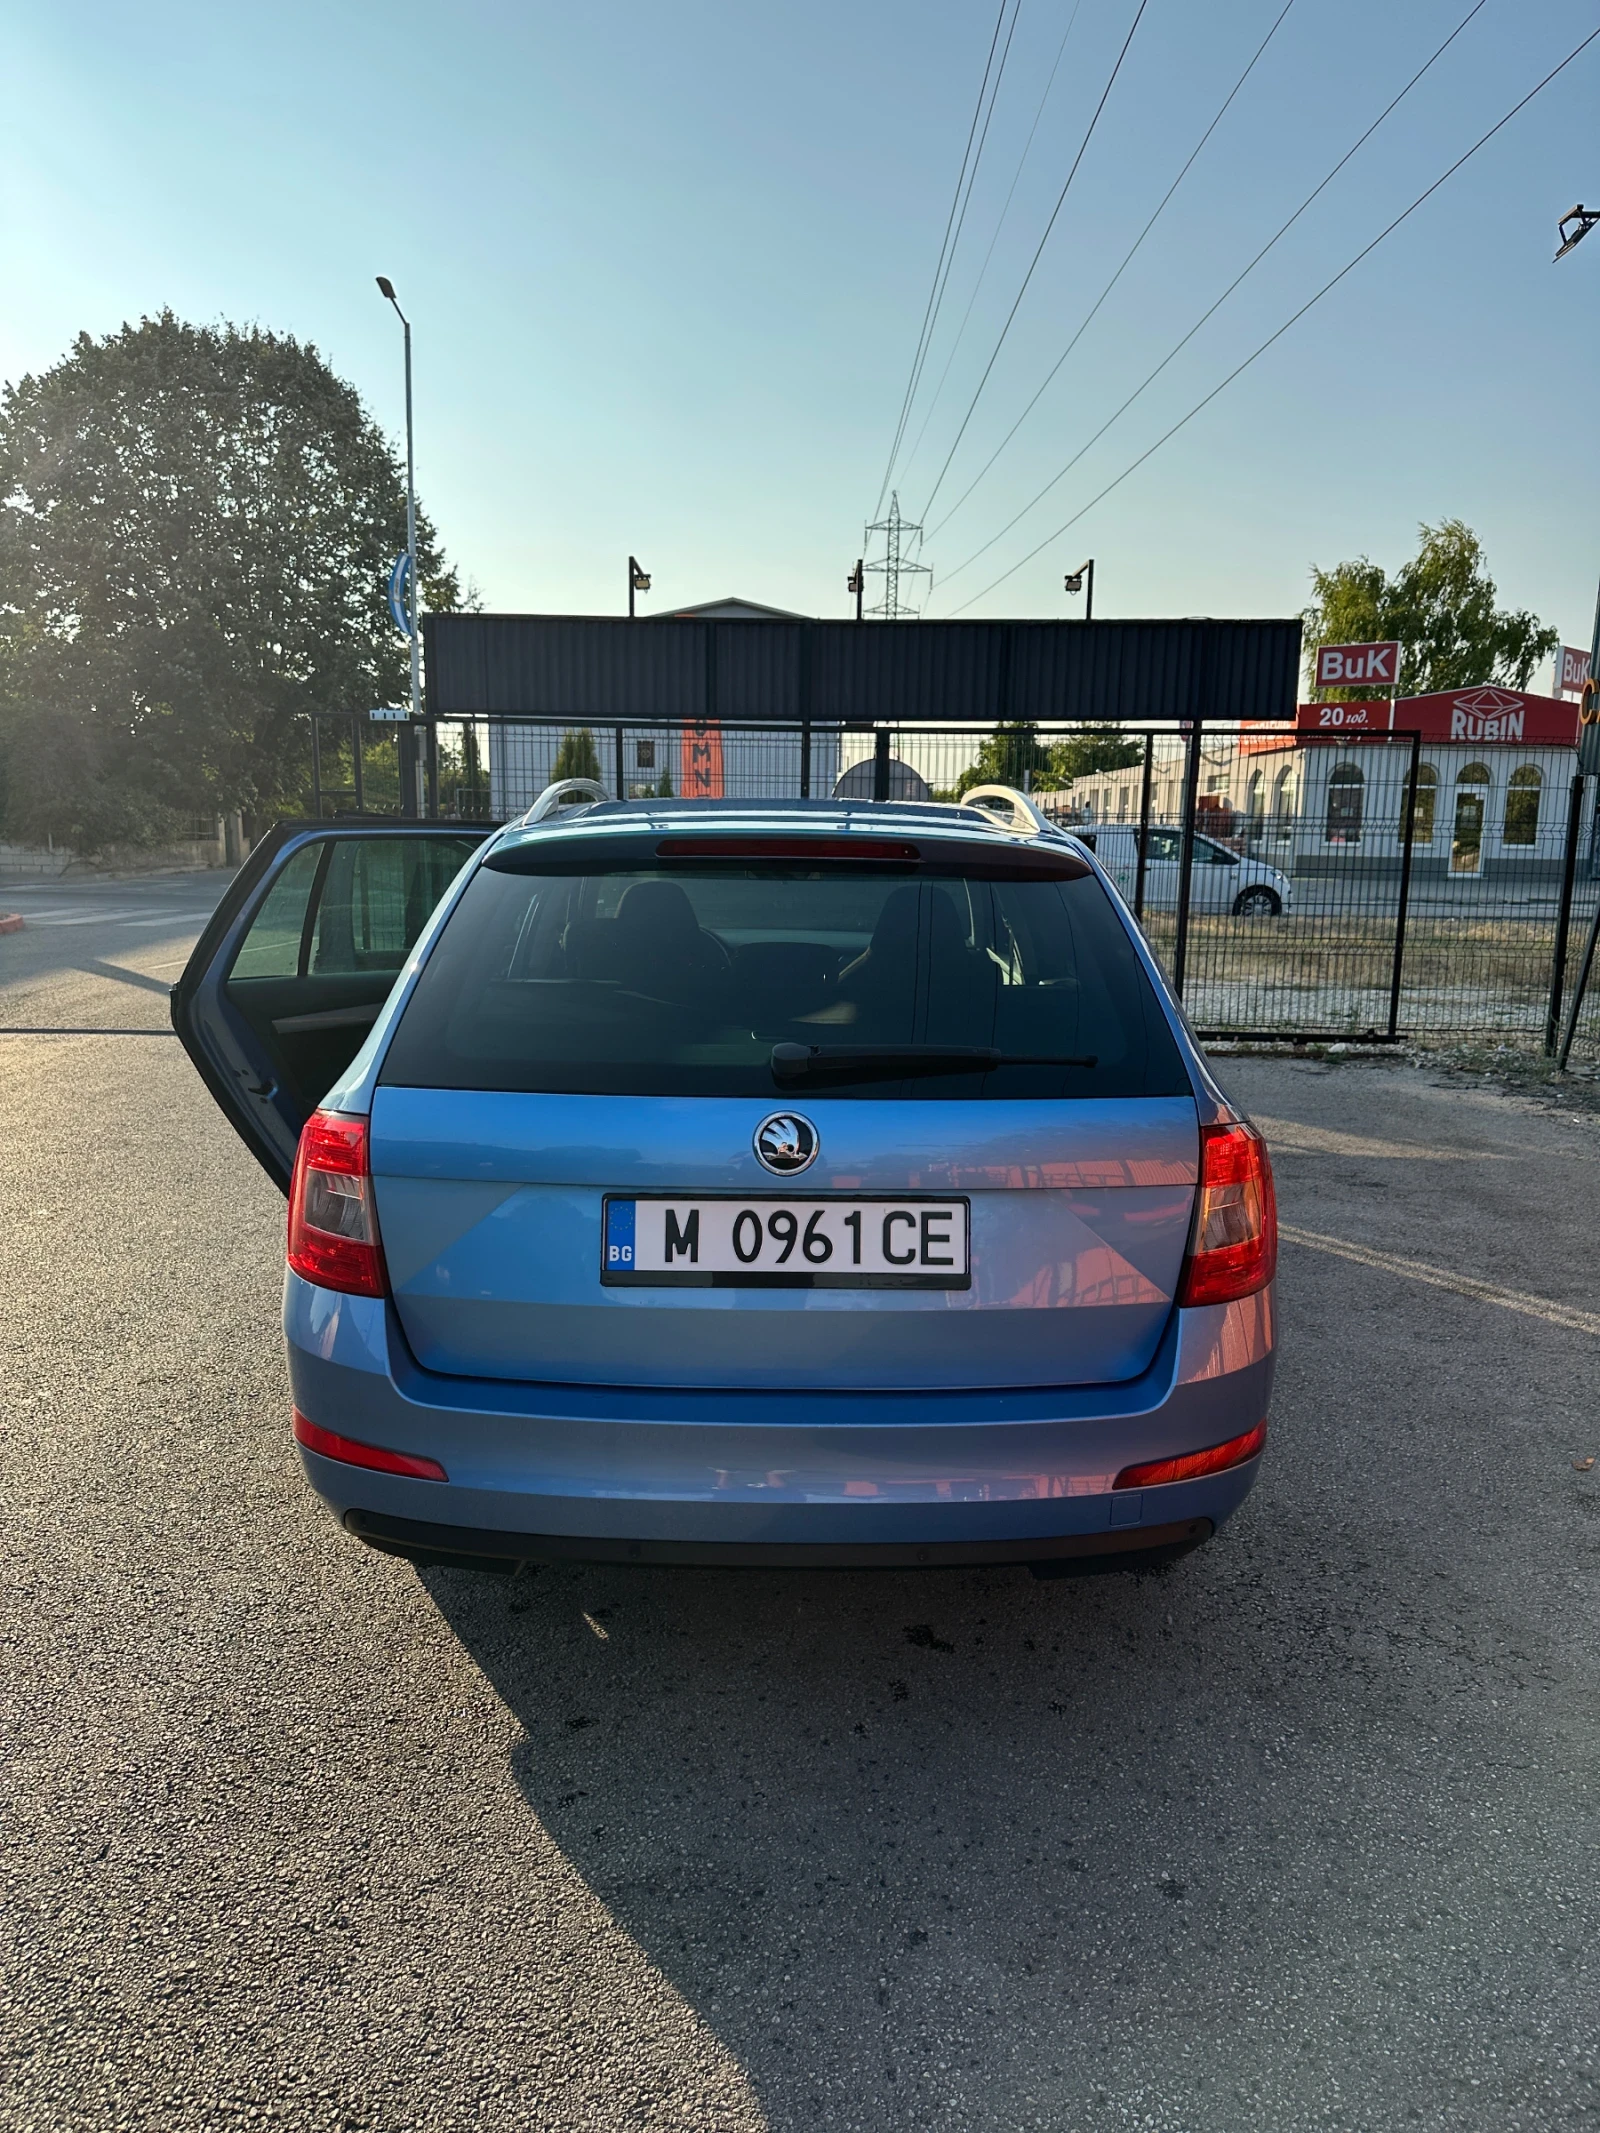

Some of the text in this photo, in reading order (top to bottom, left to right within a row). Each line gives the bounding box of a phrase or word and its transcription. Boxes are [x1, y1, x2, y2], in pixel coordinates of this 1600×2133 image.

[1319, 707, 1344, 726] 20
[1450, 708, 1525, 741] RUBIN
[609, 1245, 632, 1262] BG
